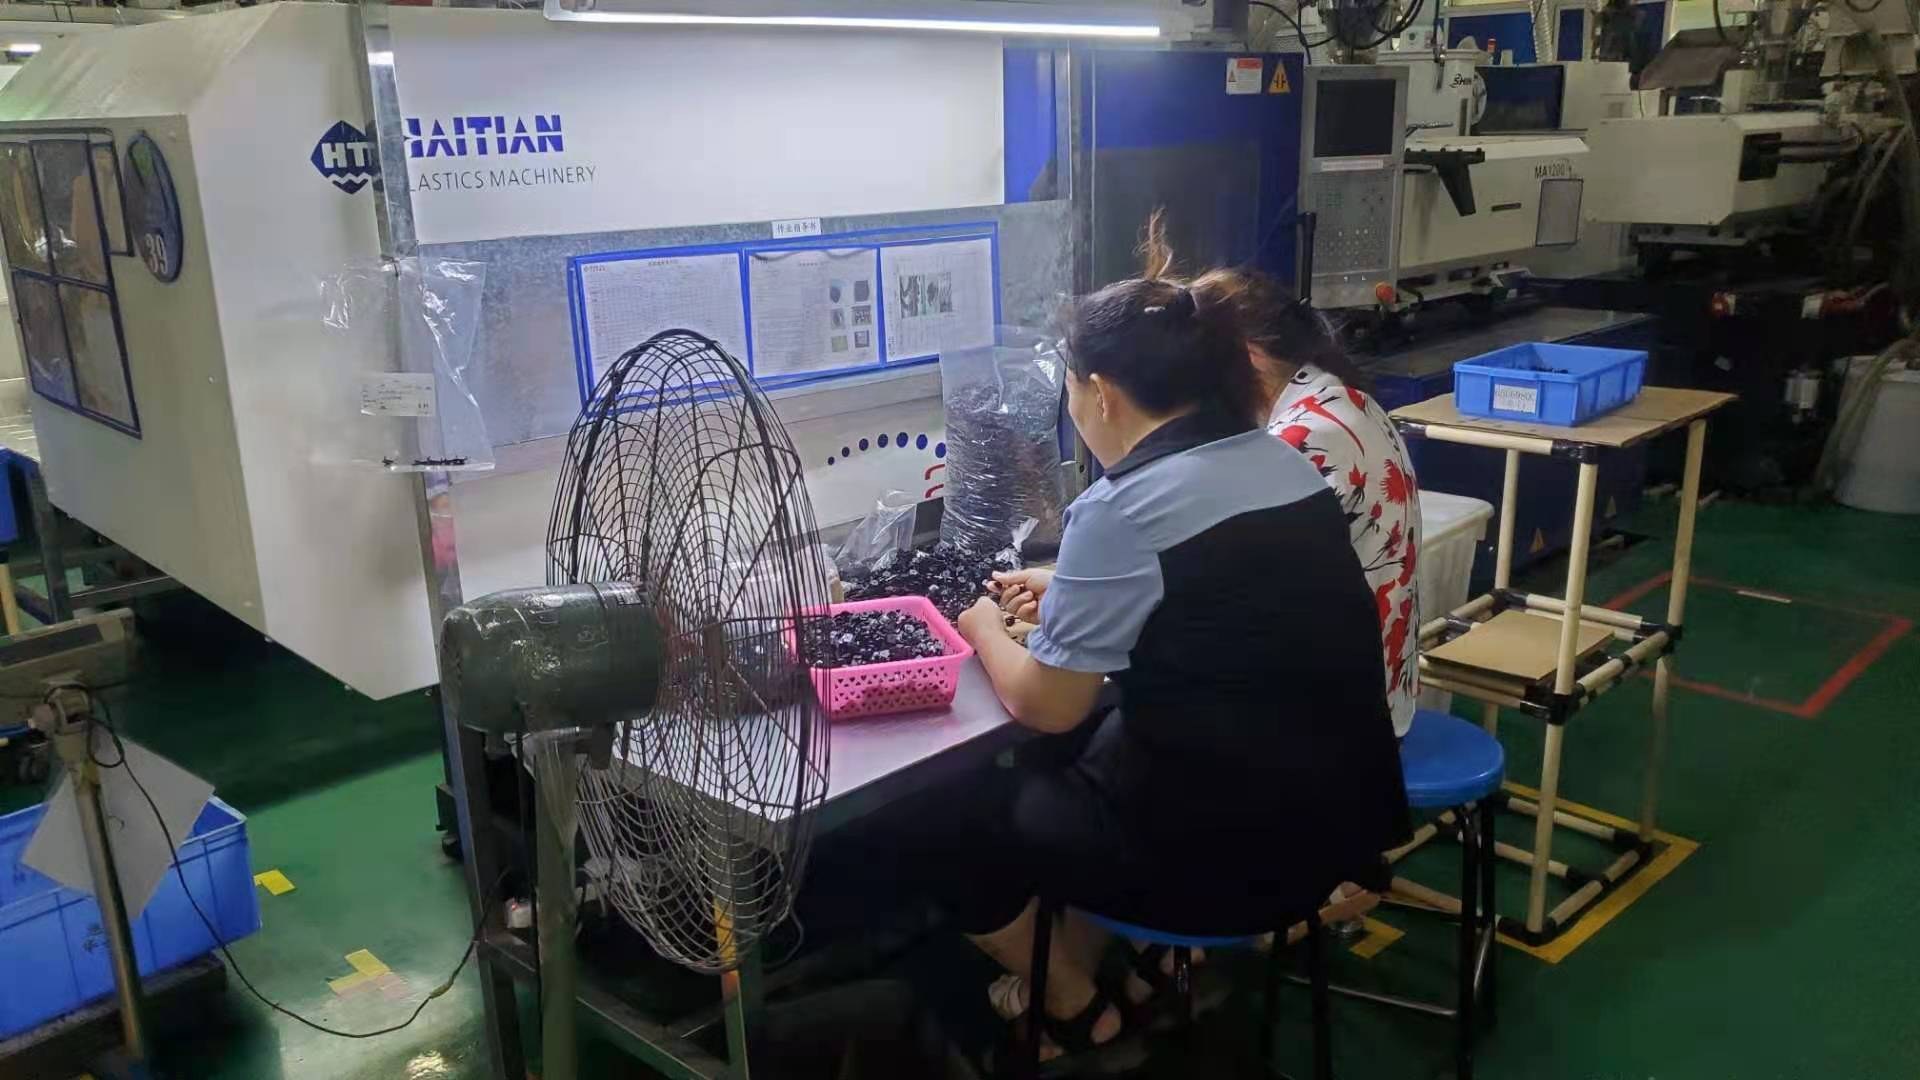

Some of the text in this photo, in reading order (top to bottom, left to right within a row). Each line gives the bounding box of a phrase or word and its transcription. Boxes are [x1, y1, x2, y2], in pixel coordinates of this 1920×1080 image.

[410, 165, 597, 192] ASTICS MACHINERY
[145, 232, 168, 274] 39
